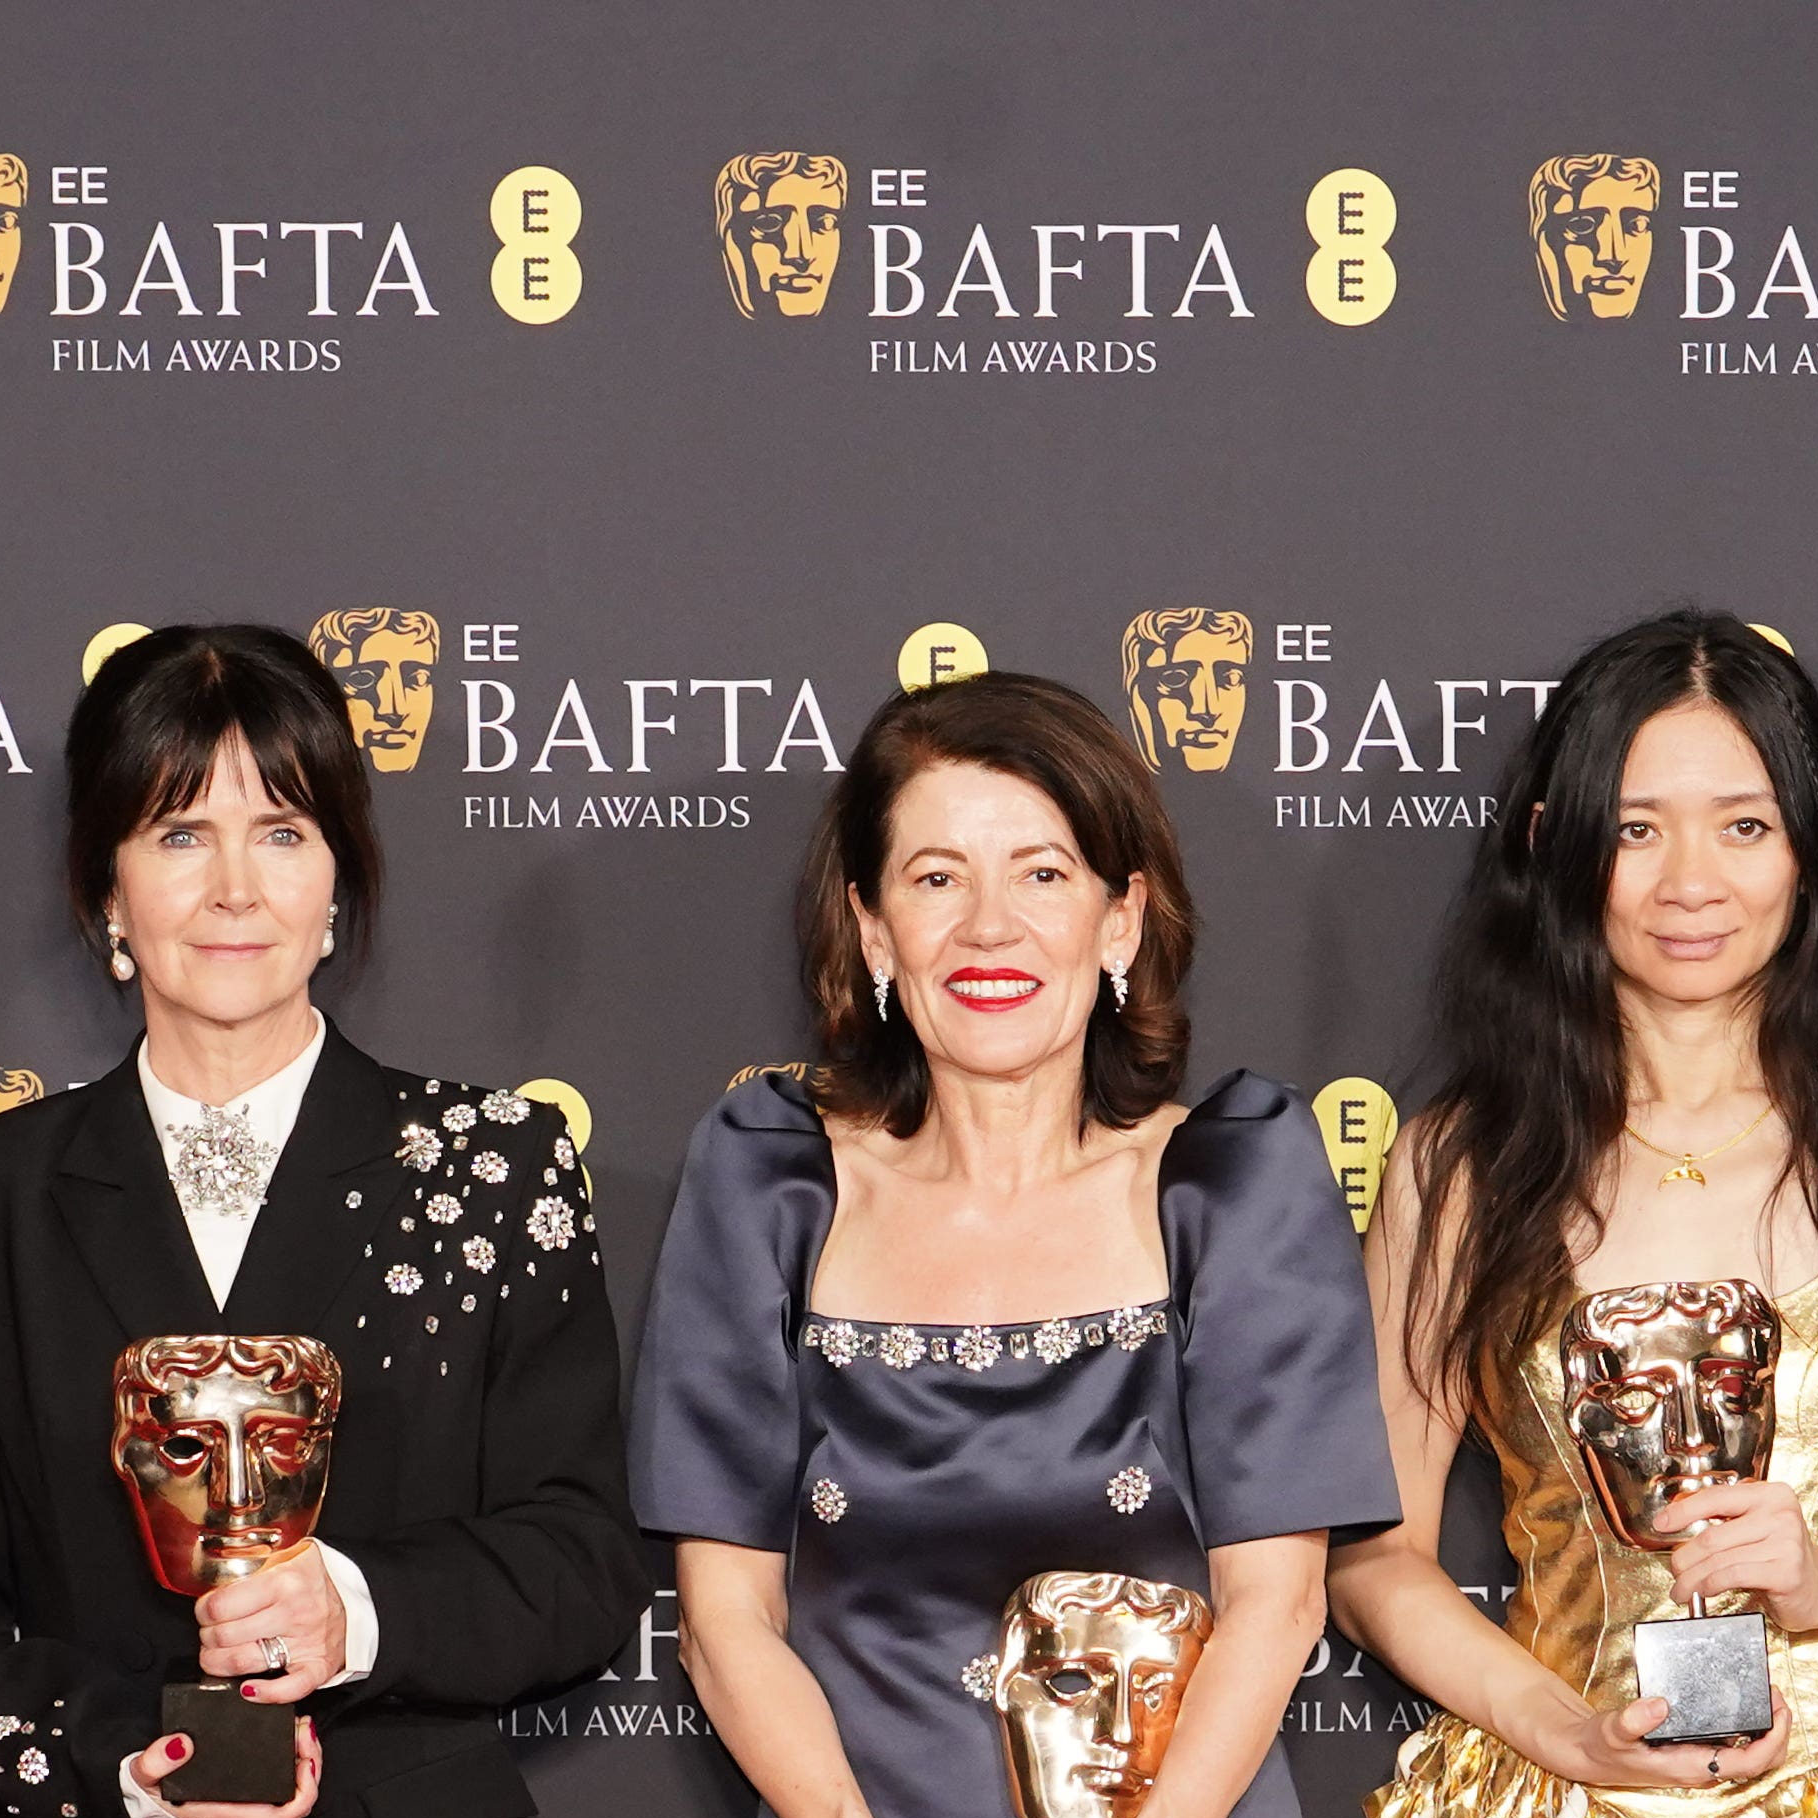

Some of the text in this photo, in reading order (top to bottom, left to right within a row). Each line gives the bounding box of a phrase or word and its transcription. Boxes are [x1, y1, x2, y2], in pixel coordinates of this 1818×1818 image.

[52, 167, 108, 204] EE
[871, 169, 926, 206] EE
[1684, 172, 1738, 208] EE
[49, 221, 439, 316] BAFTA
[868, 223, 1255, 317] BAFTA
[53, 340, 340, 371] FILM AWARDS
[870, 341, 1156, 373] FILM AWARDS
[1681, 343, 1777, 374] FILM
[464, 625, 519, 661] EE
[1277, 625, 1331, 661] EE
[461, 679, 846, 772] BAFTA
[465, 796, 749, 827] FILM AWARDS
[1275, 796, 1371, 827] FILM
[584, 1704, 715, 1736] AWAR
